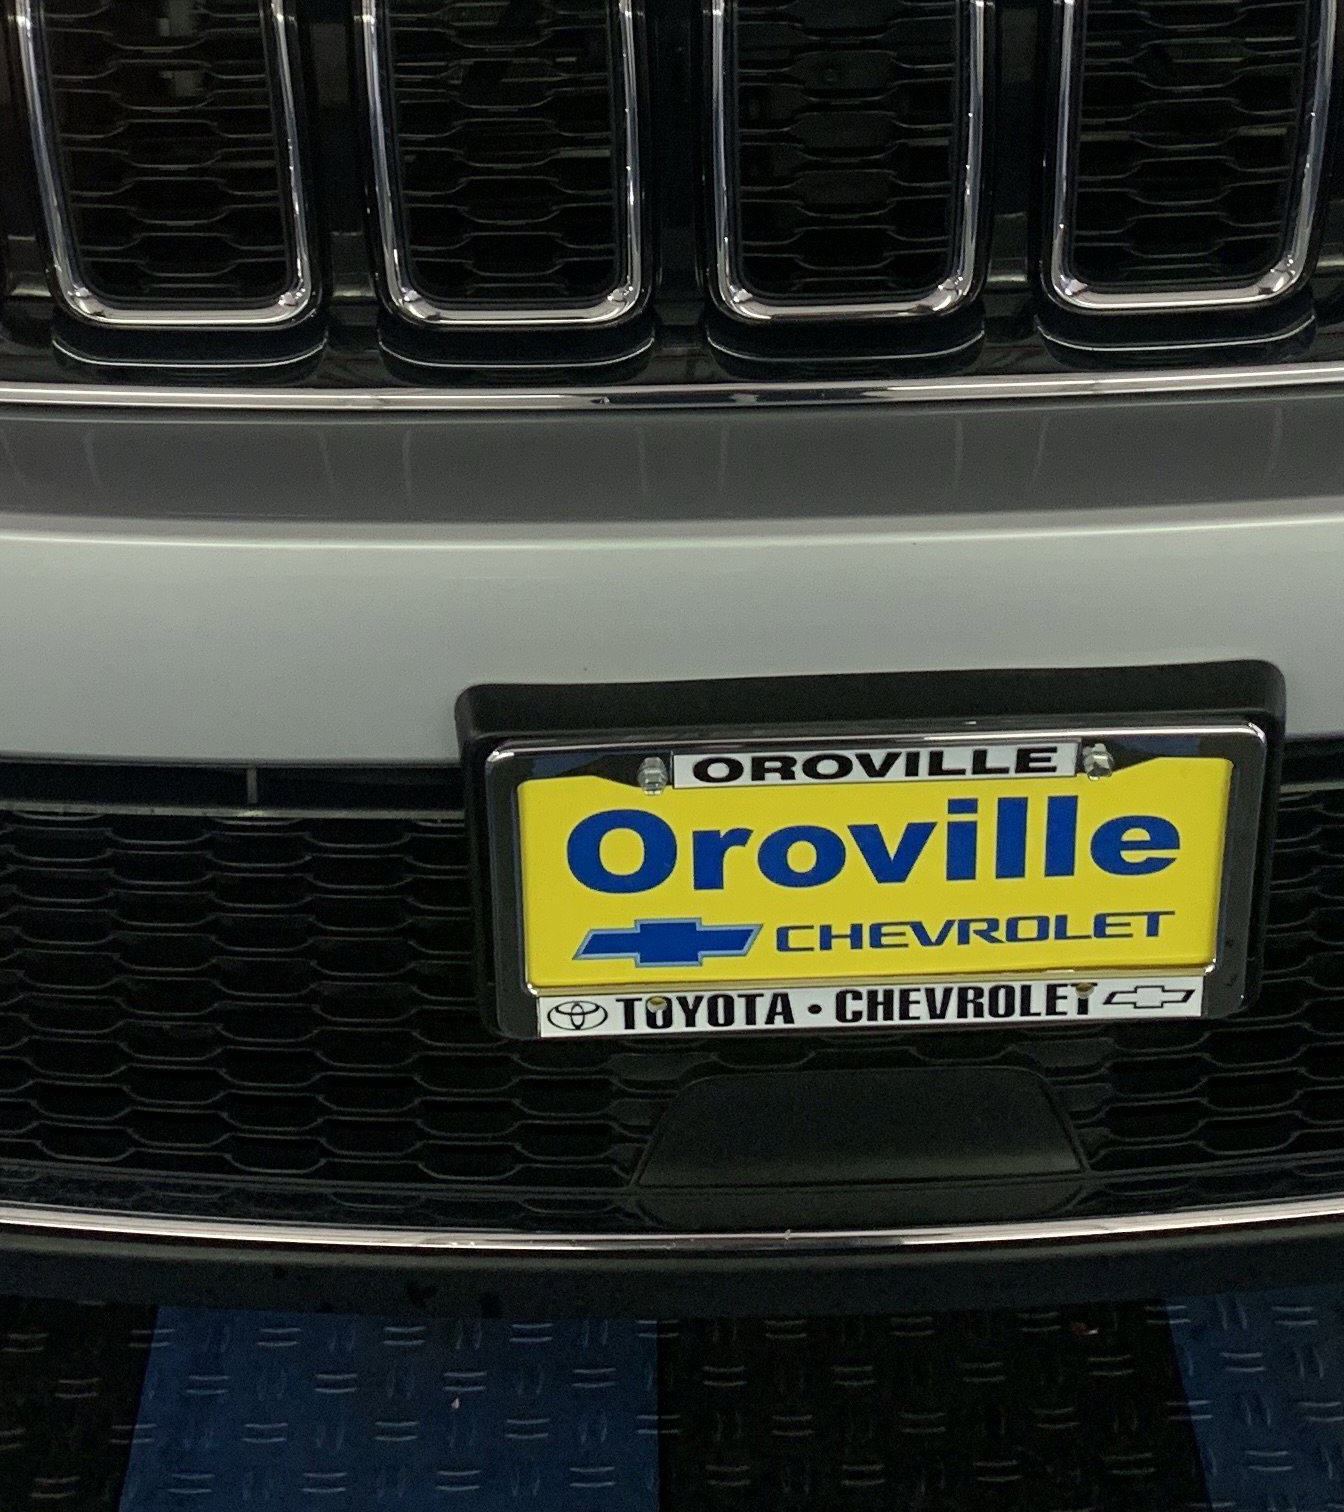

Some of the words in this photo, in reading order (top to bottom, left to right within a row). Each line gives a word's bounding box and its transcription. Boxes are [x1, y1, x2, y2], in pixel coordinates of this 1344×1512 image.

[692, 746, 1059, 783] OROVILLE
[566, 795, 1182, 894] Oroville
[776, 910, 1176, 953] CHEVROLET
[615, 992, 795, 1030] TOYOTA
[835, 982, 1098, 1023] CHEVROLET
